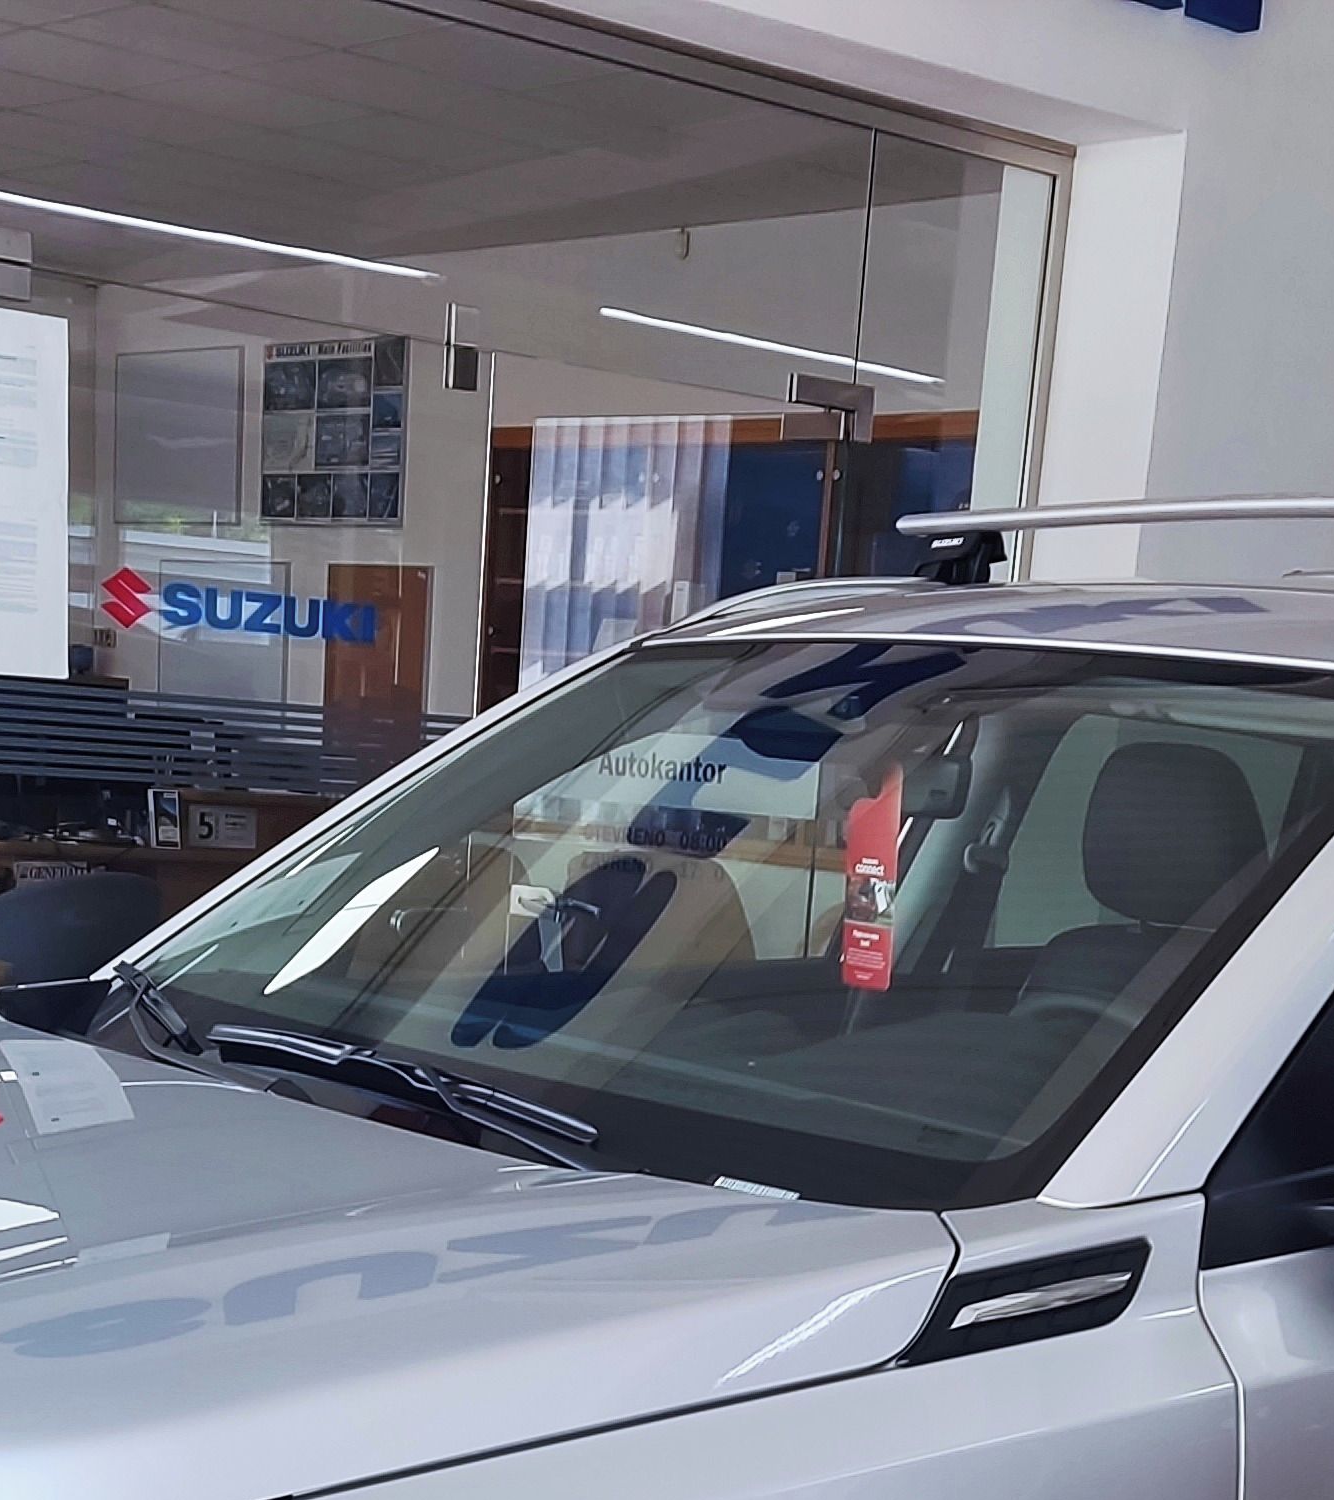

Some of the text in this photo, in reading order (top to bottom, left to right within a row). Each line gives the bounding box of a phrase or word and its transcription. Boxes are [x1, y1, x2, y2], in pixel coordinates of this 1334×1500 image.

[163, 582, 378, 644] SUZUKI
[598, 752, 727, 784] Autokantor
[198, 811, 214, 839] 5
